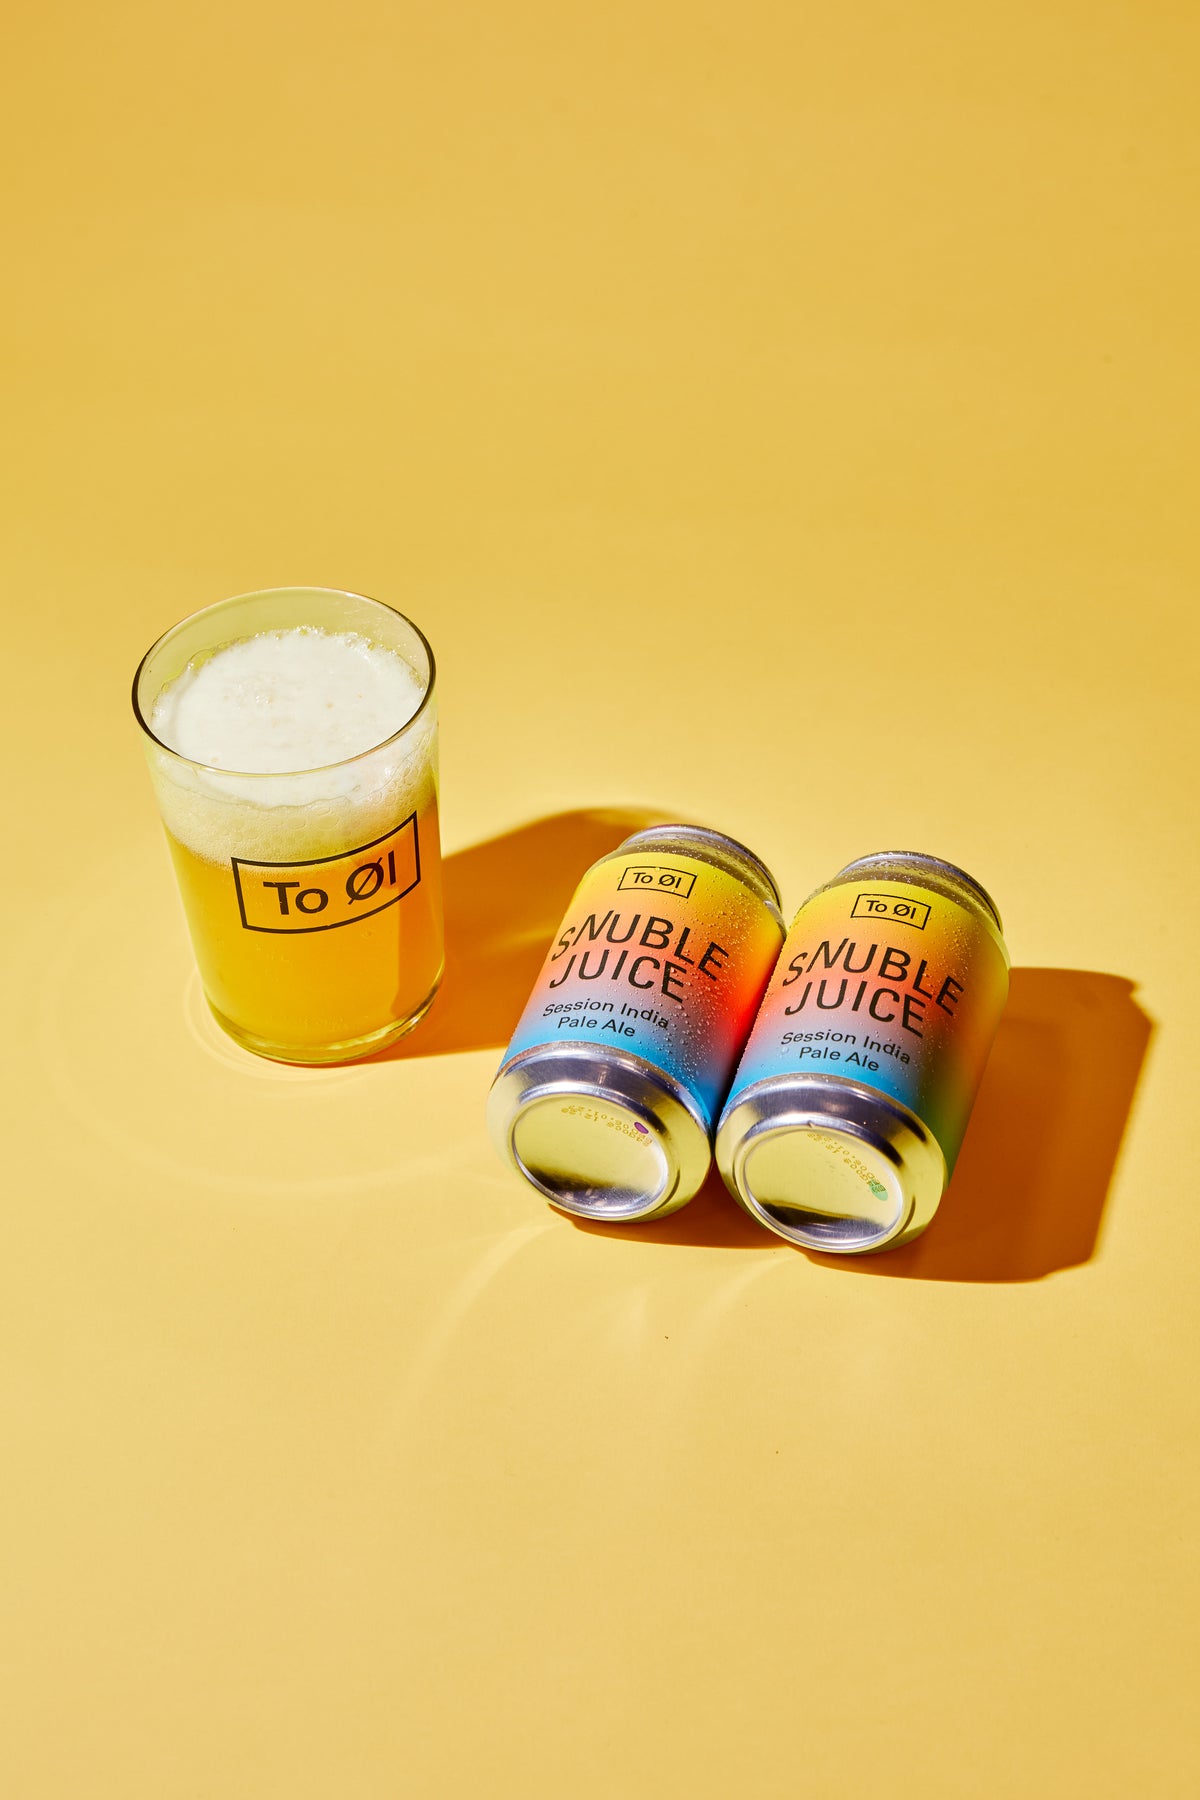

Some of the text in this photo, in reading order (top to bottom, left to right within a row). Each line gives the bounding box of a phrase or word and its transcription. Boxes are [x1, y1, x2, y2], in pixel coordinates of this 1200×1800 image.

[263, 850, 396, 915] To Øl
[633, 872, 682, 889] To Øl
[866, 900, 917, 919] To Øl
[551, 910, 730, 981] SNUBLE
[549, 949, 687, 1004] JUICE
[782, 938, 965, 1017] SNUBLE
[542, 998, 669, 1029] Session India
[558, 1015, 636, 1037] Pale Ale
[784, 978, 926, 1039] JUICE
[780, 1029, 910, 1065] Session India
[799, 1046, 880, 1072] Pale Ale
